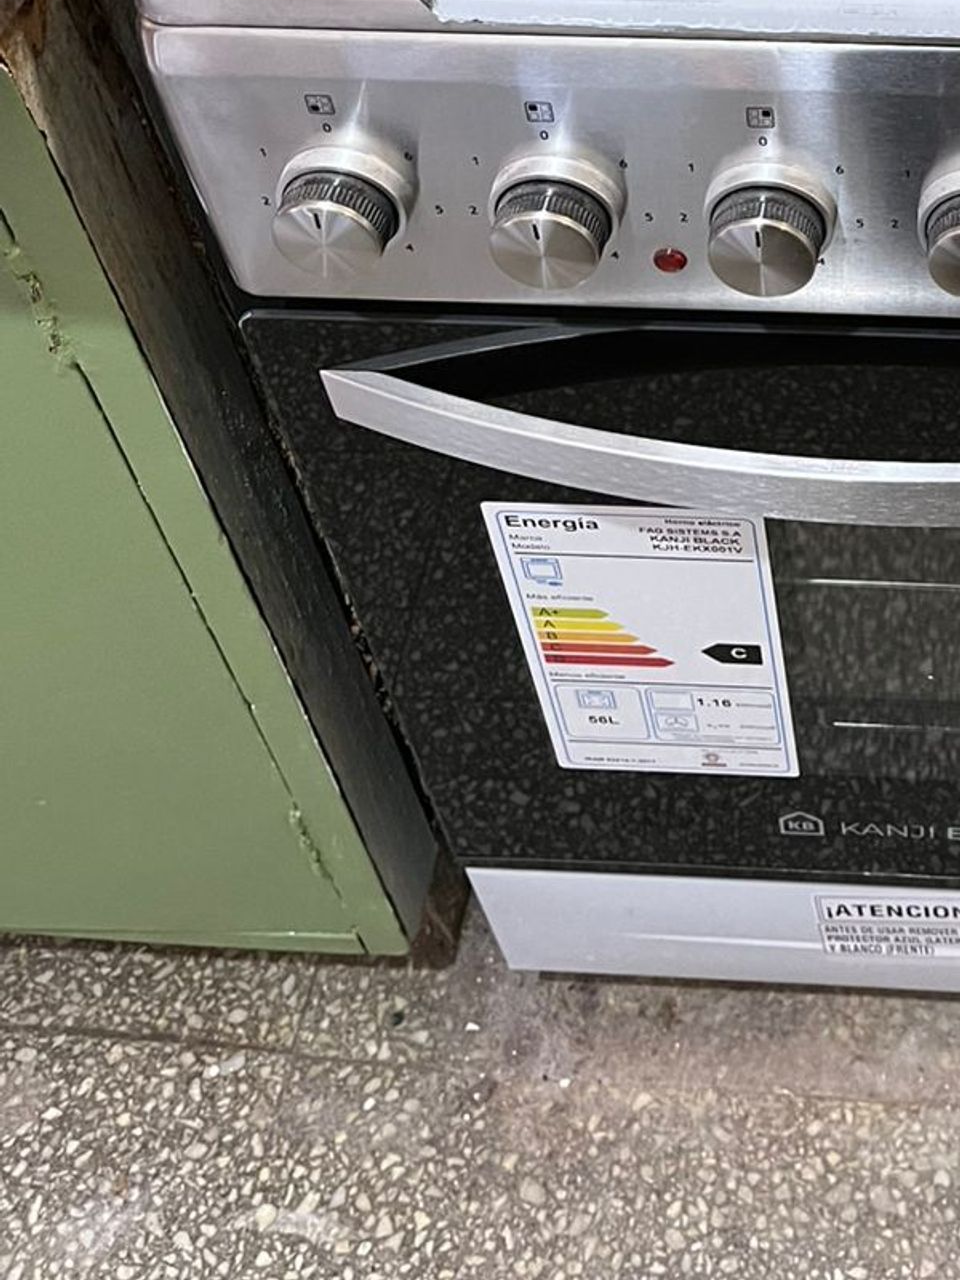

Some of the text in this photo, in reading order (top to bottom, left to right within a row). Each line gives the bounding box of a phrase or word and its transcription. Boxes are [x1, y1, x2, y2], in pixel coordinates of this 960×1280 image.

[619, 158, 628, 168] 6
[835, 164, 845, 174] 6
[261, 195, 272, 206] 2
[469, 205, 479, 215] 2
[679, 212, 689, 222] 2
[891, 218, 900, 227] 2
[504, 514, 599, 532] Energía
[543, 620, 556, 628] A
[731, 648, 748, 659] C
[696, 698, 732, 708] 1.16
[788, 821, 815, 830] KB
[841, 821, 934, 839] KANJI
[825, 925, 857, 934] ANTES
[861, 926, 875, 934] DE
[879, 927, 905, 935] USAR
[909, 927, 957, 936] REMOVER
[827, 935, 890, 943] PROTECTOR
[894, 936, 921, 944] AZUL
[840, 944, 882, 954] BLANCO
